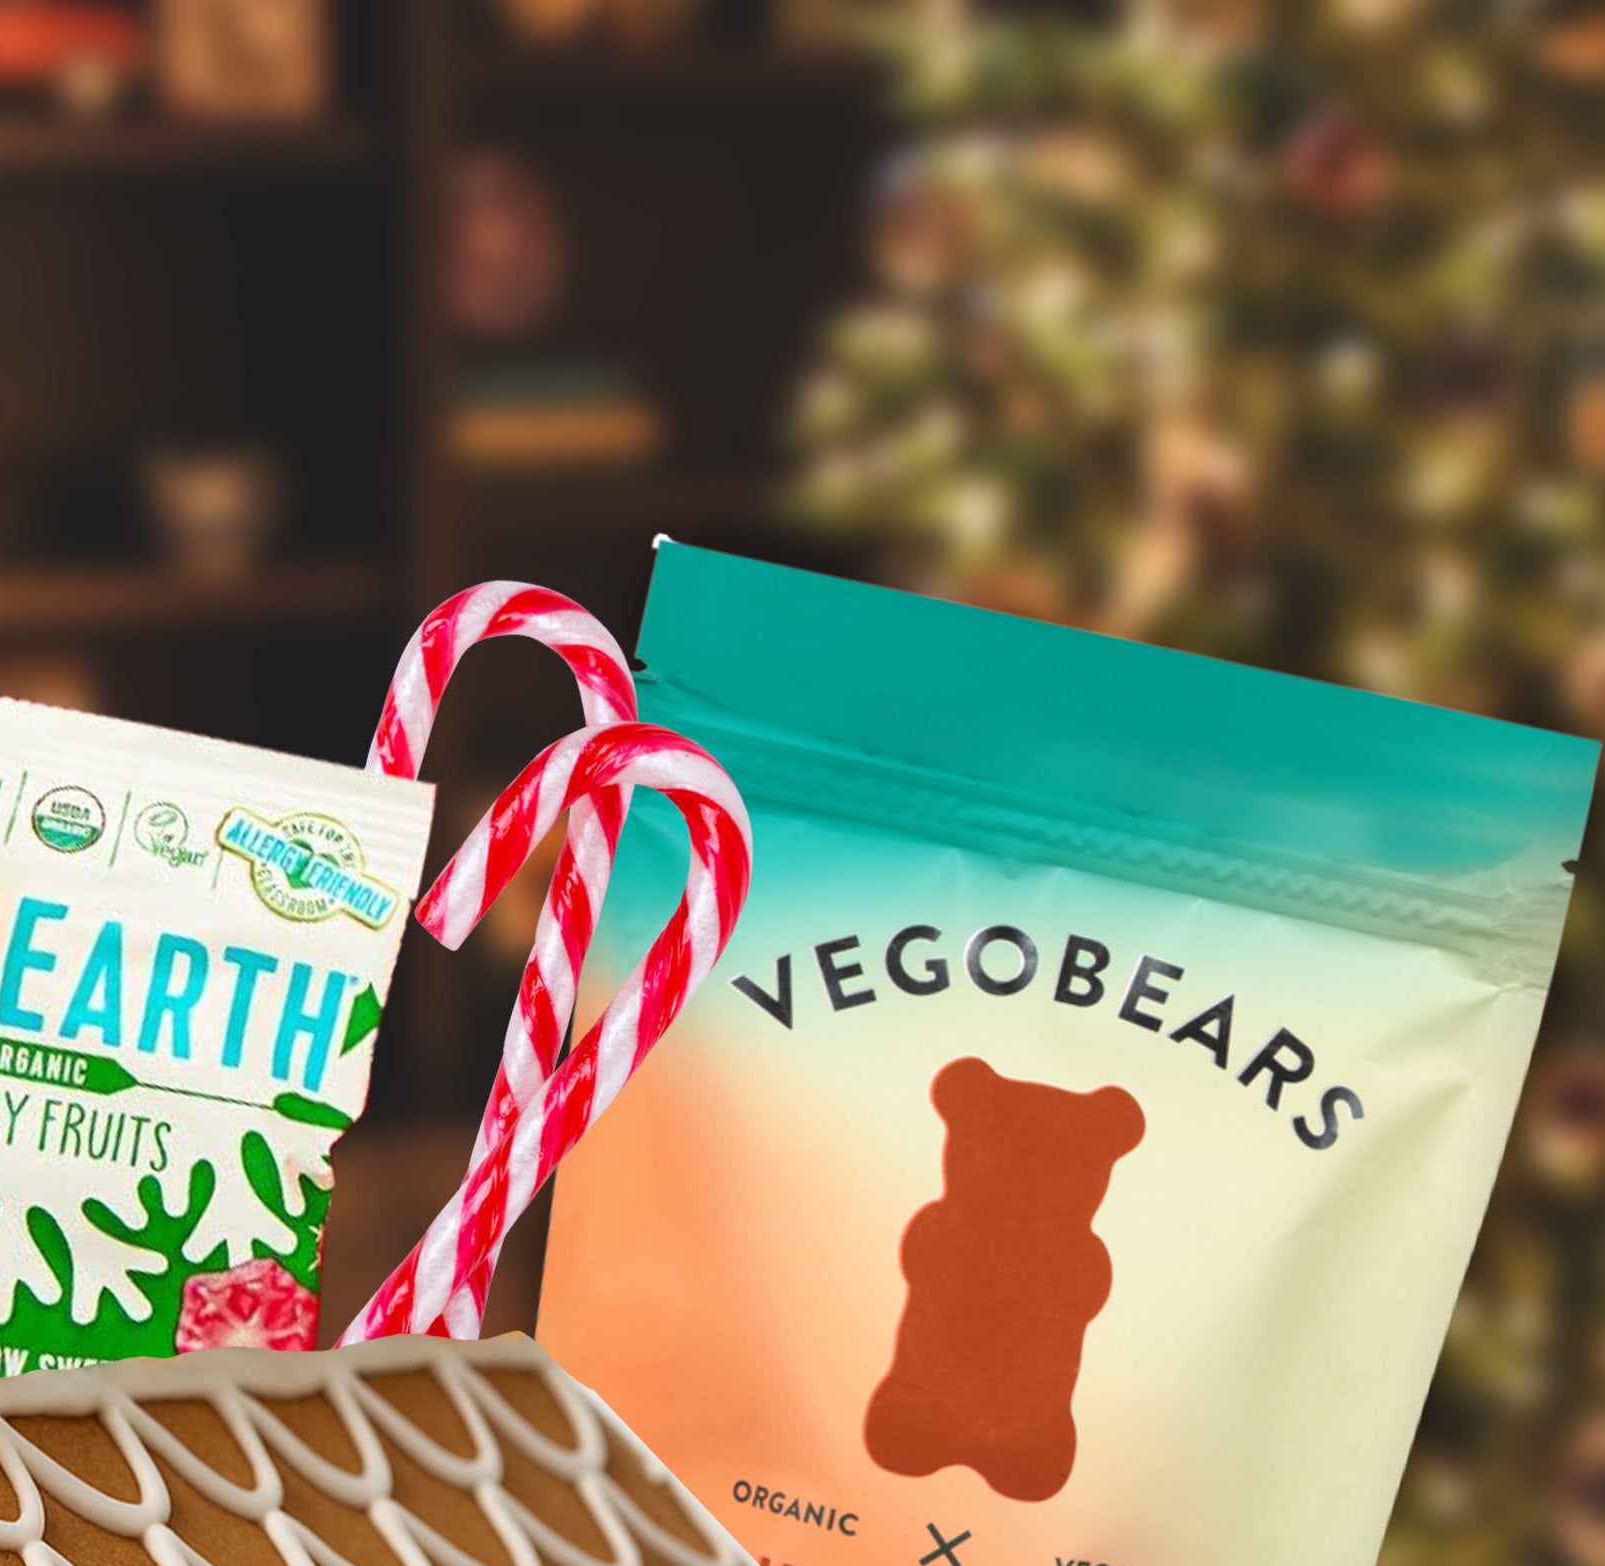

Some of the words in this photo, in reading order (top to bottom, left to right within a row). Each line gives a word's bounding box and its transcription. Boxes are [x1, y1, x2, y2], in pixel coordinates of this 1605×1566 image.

[225, 818, 311, 876] ALLERGY
[305, 861, 393, 922] FRIENDLY
[729, 924, 1364, 1150] VEGOBEARS
[38, 1098, 172, 1172] FRUITS
[732, 1480, 859, 1537] ORGANIC
